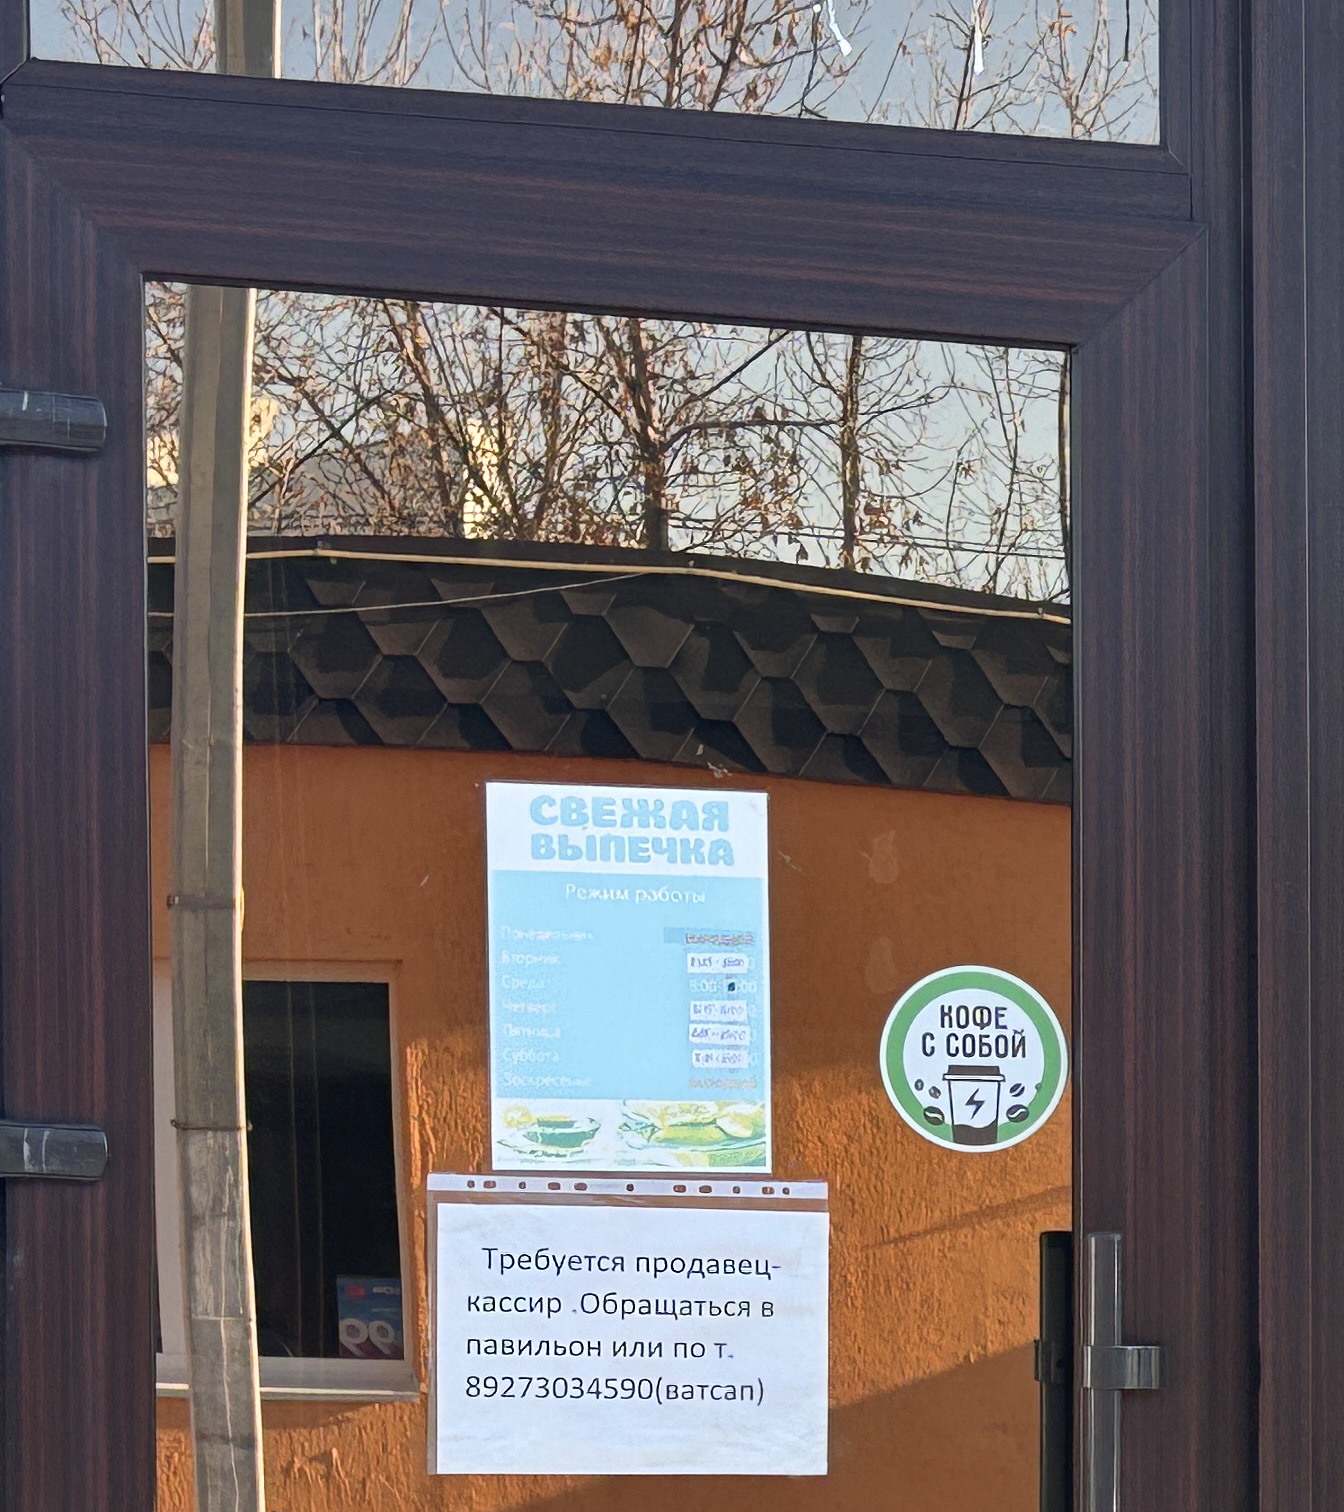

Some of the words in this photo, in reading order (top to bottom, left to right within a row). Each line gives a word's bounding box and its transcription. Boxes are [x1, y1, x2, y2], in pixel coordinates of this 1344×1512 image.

[529, 795, 730, 832] СВЕЖАЯ
[530, 833, 735, 866] ВЫПЕЧКА
[565, 883, 629, 900] Режим
[635, 885, 706, 904] работы
[940, 1004, 1008, 1030] КОФЕ
[921, 1032, 936, 1057] С
[946, 1029, 1027, 1058] СОБОЙ
[481, 1248, 625, 1275] Требуется
[636, 1255, 782, 1280] продавец-
[467, 1294, 562, 1319] кассир
[761, 1301, 775, 1318] в
[466, 1339, 601, 1357] павильон
[612, 1341, 663, 1358] или
[673, 1342, 706, 1359] по
[713, 1342, 734, 1359] т.
[465, 1376, 764, 1405] 89273034590(ватсап)
